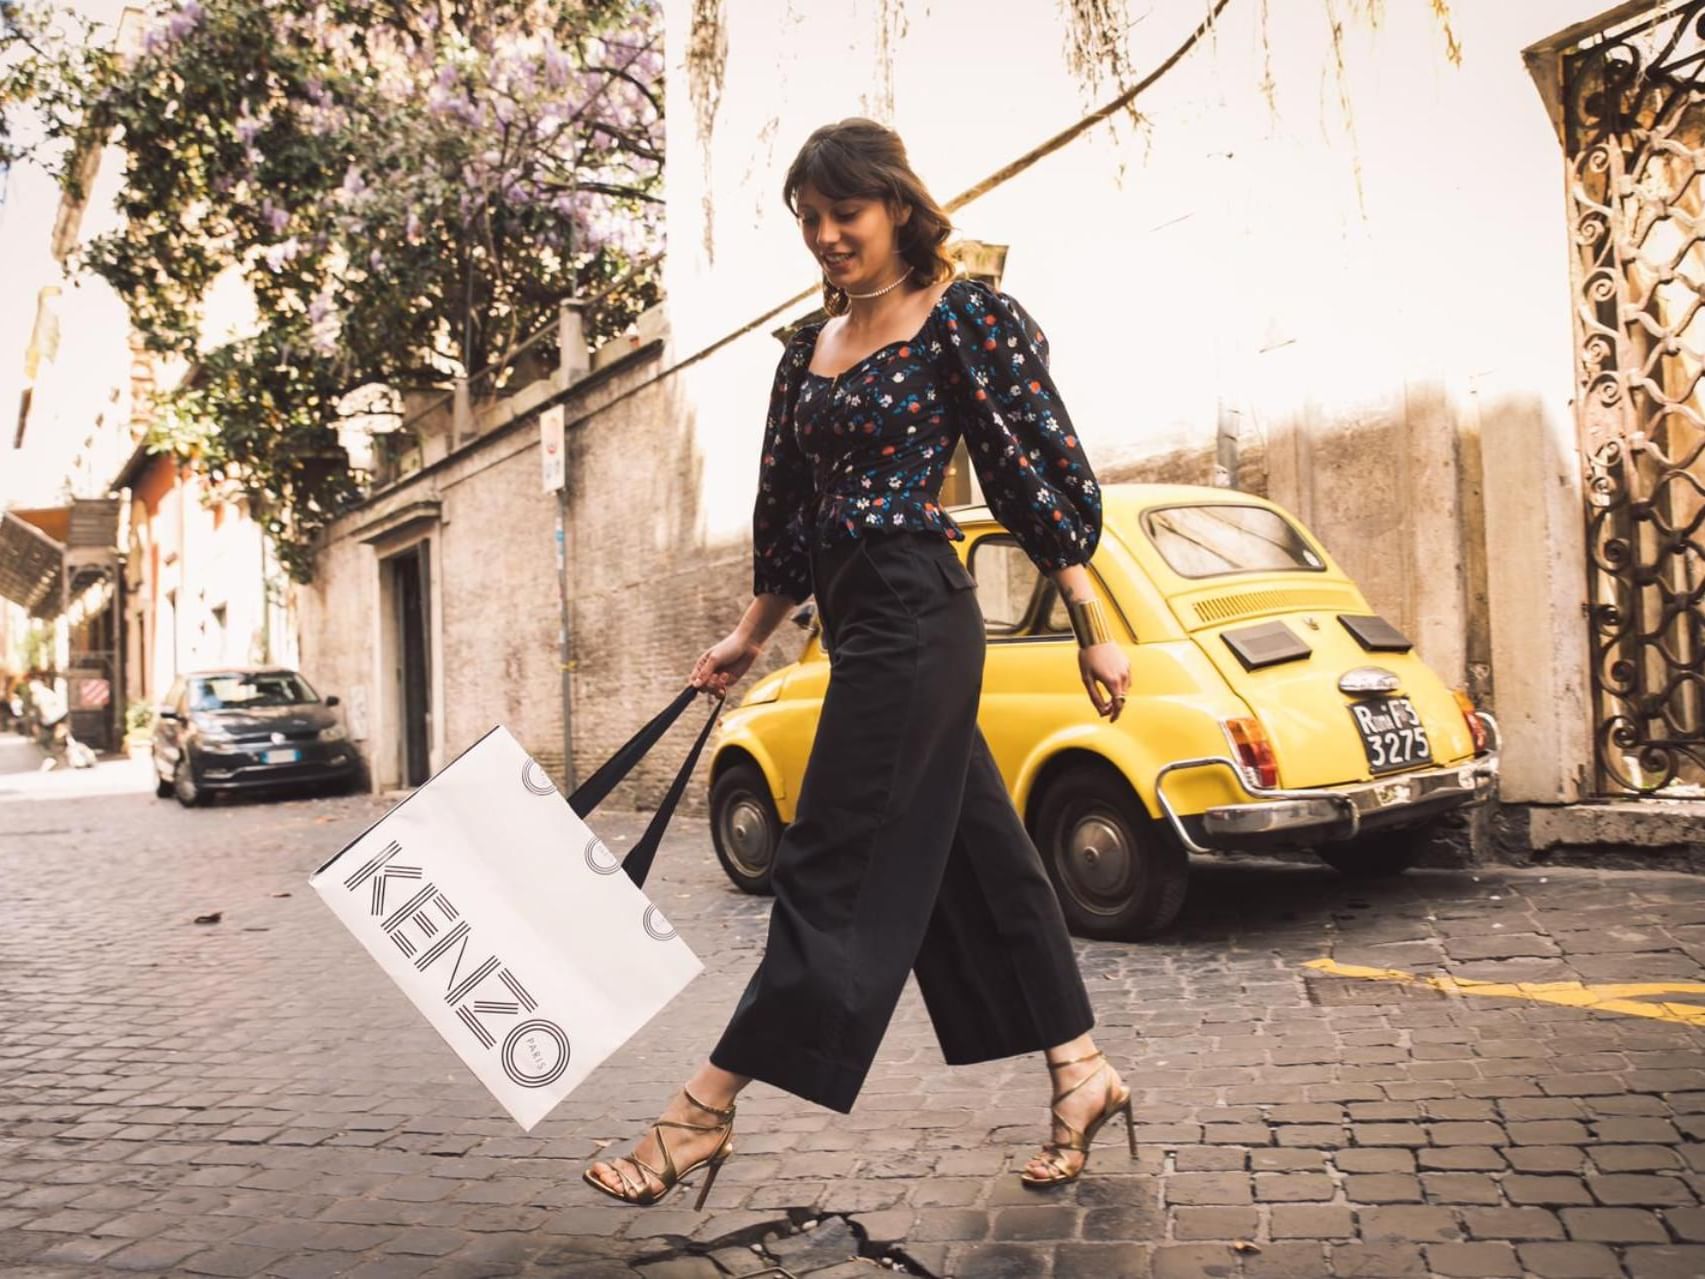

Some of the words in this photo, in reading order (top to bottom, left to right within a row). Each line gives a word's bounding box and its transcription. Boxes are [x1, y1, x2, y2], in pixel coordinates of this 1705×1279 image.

[1367, 726, 1429, 766] 3275
[344, 840, 570, 1088] KENZO
[526, 1037, 547, 1071] PARIS
